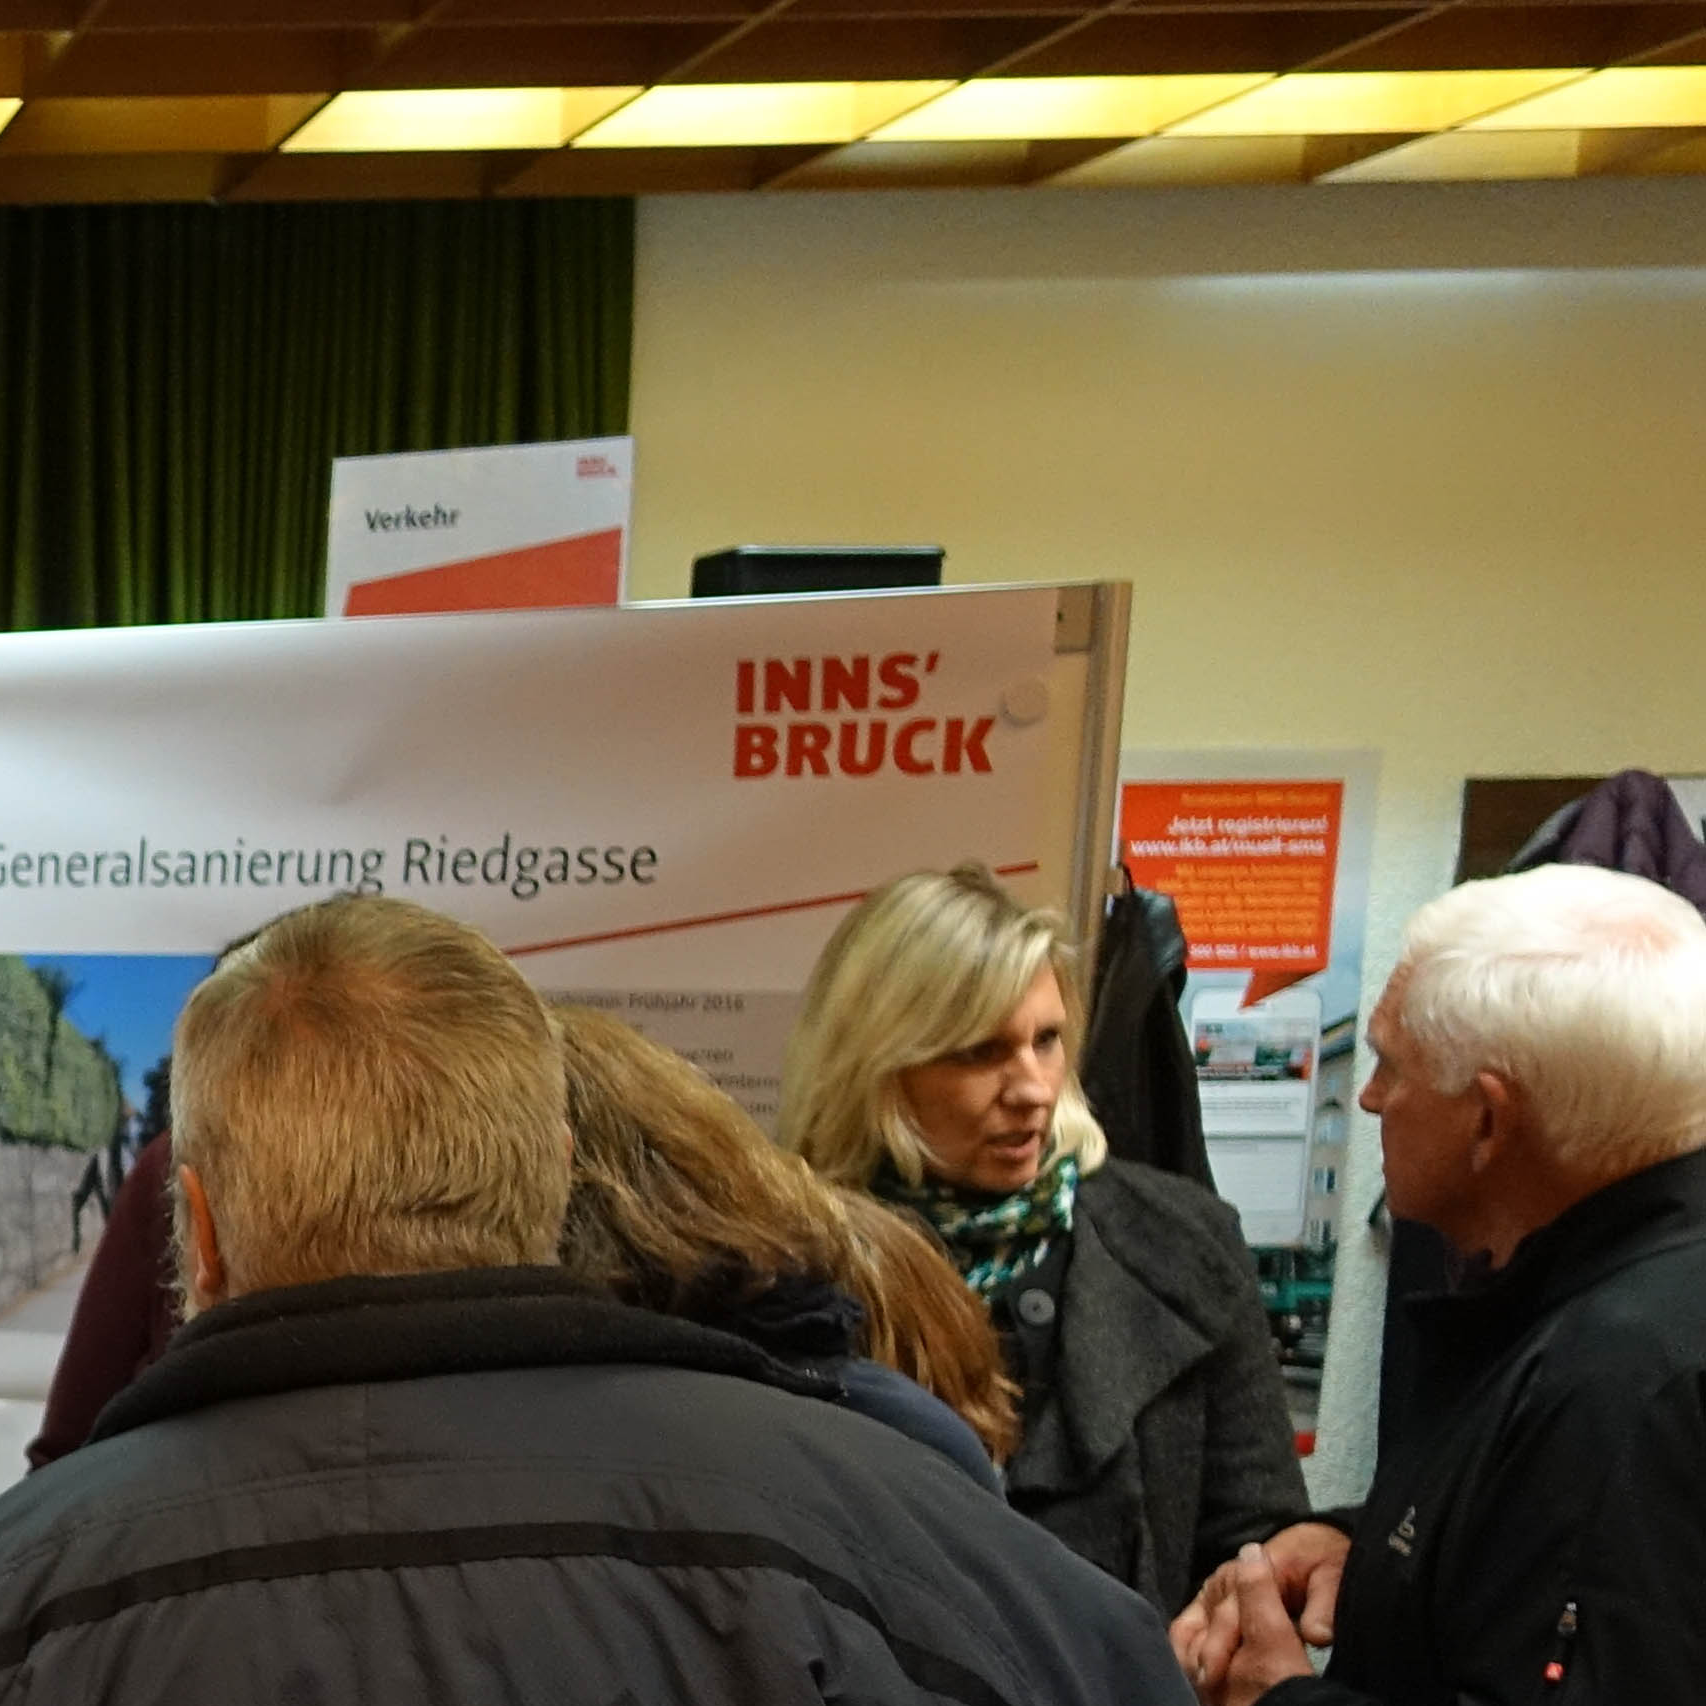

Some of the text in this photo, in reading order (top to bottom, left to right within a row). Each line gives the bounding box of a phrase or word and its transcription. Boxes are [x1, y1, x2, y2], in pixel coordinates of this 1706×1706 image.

[364, 502, 460, 532] Verkehr
[733, 715, 996, 781] BRUCK
[401, 832, 660, 901] Riedgasse
